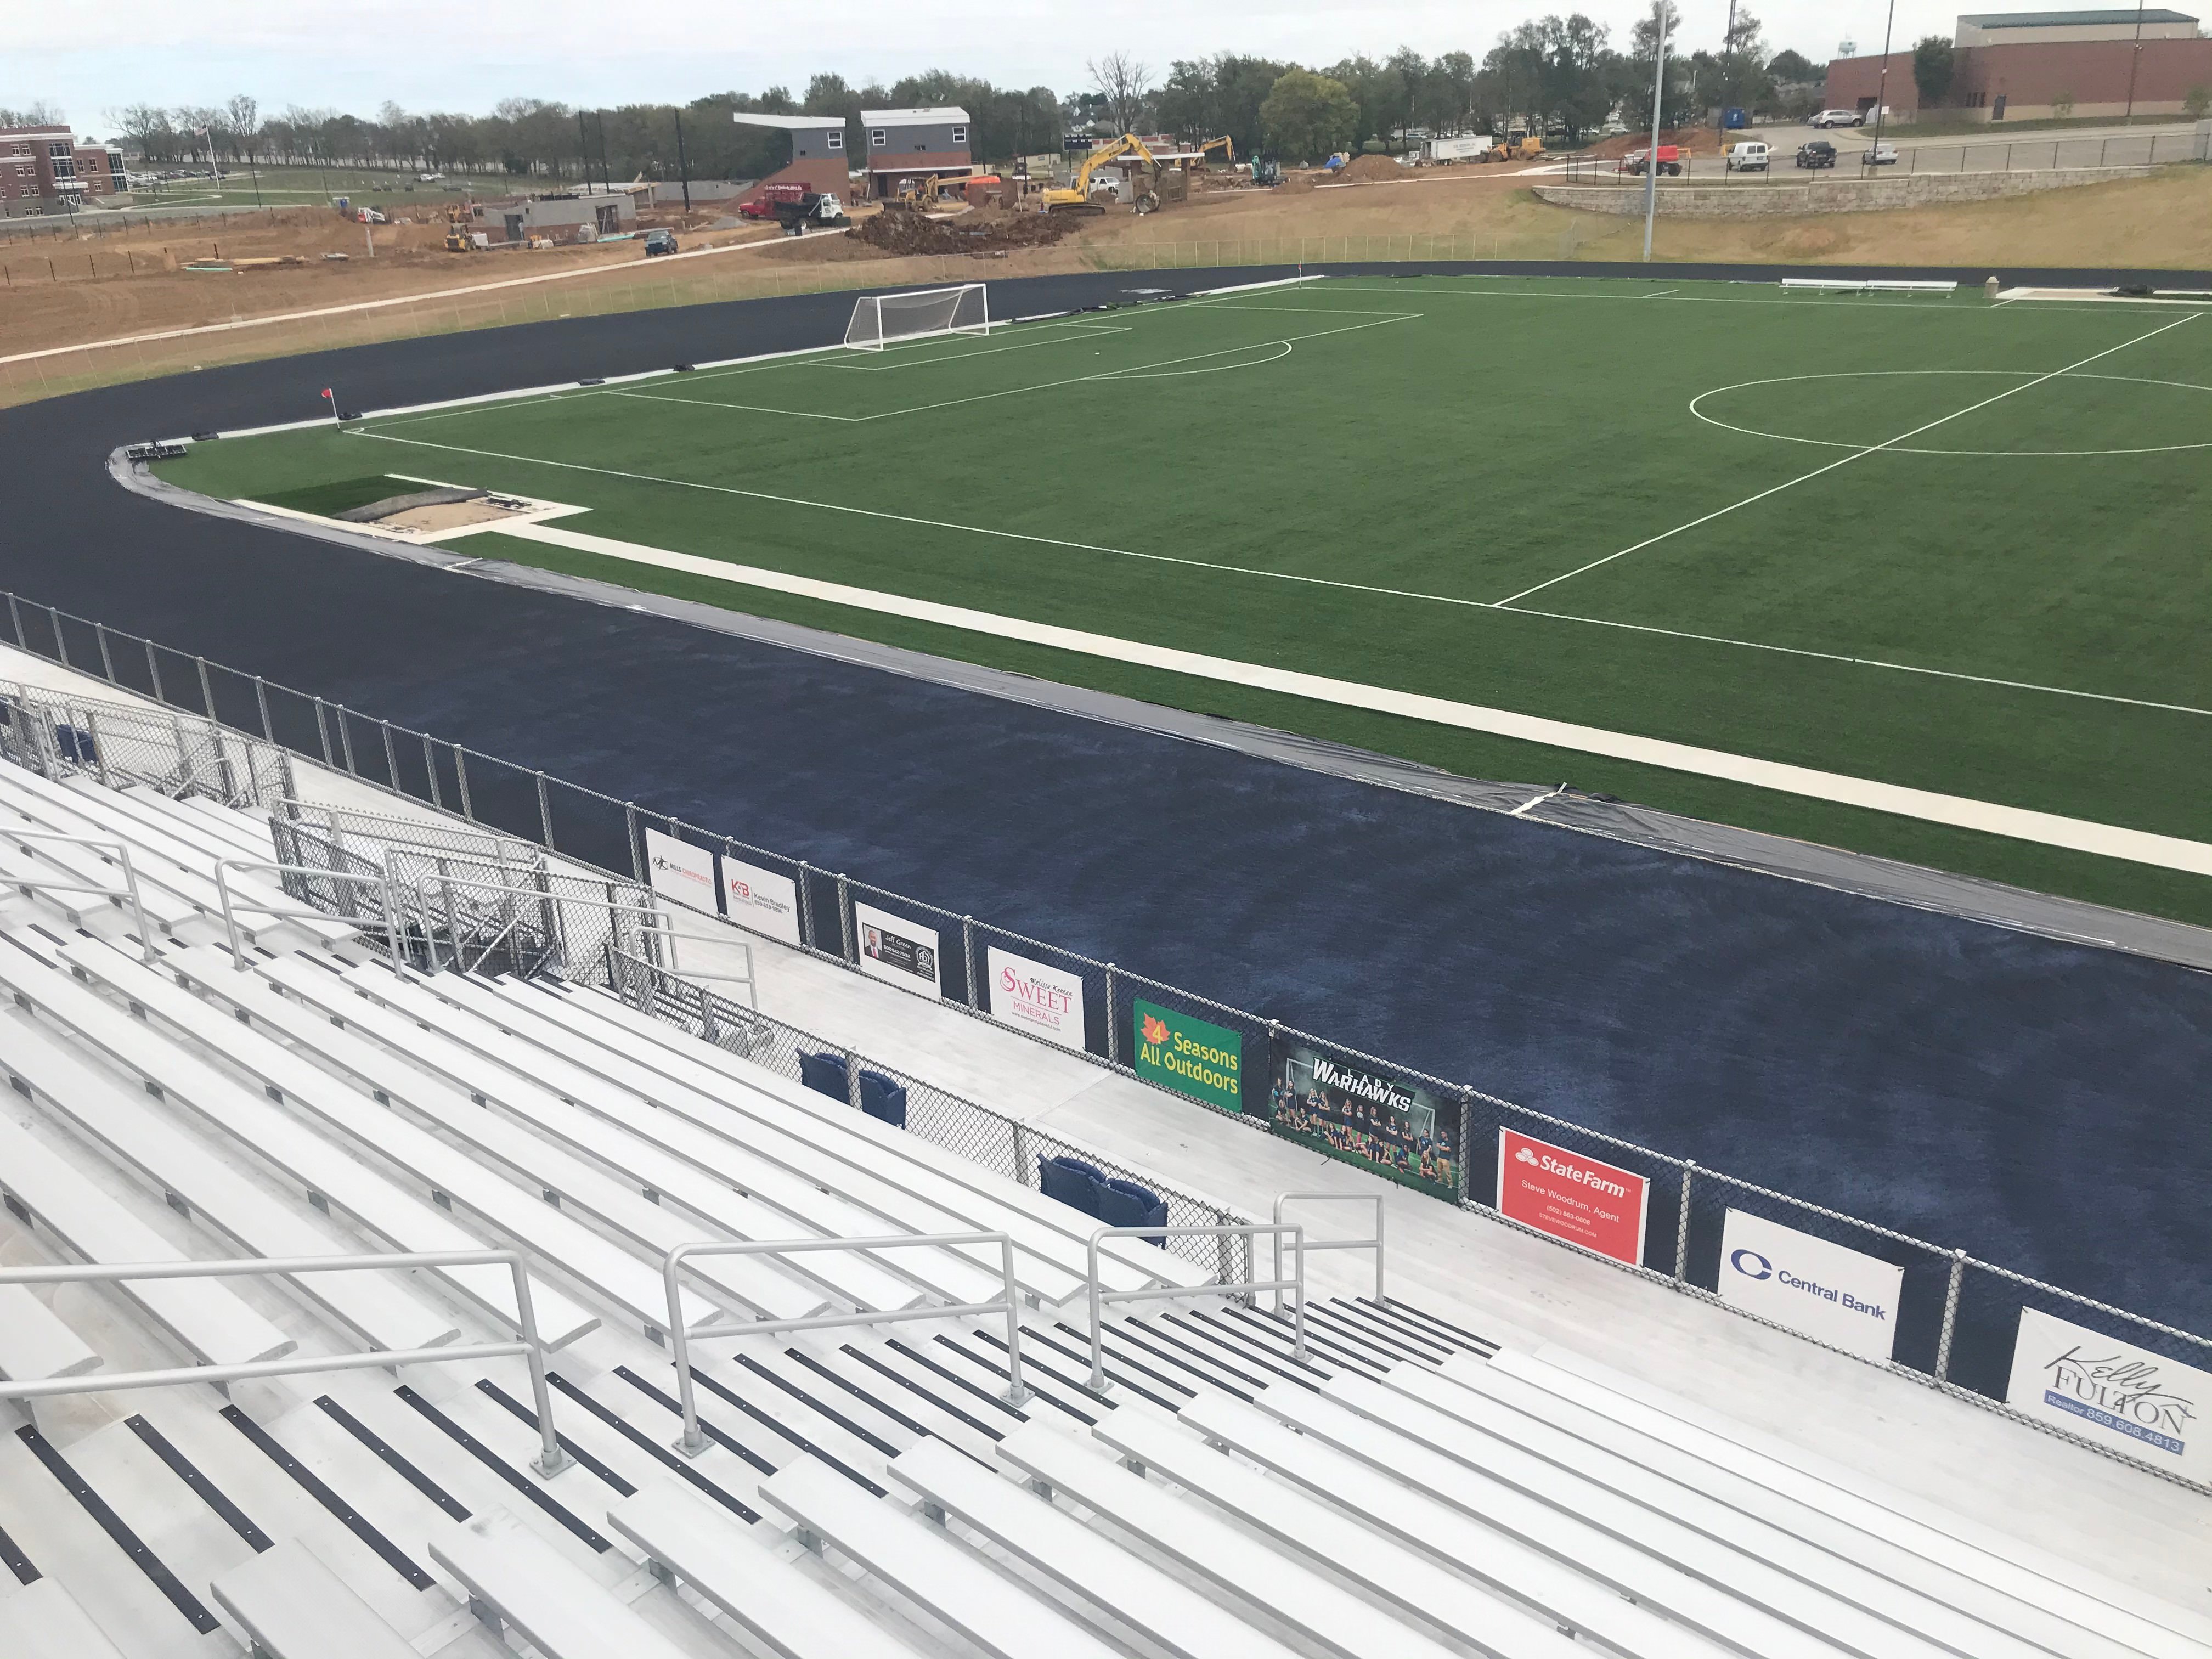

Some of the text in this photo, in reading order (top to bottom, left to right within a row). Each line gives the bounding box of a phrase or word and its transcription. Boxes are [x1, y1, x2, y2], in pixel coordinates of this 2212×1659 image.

[754, 893, 769, 903] Kevin
[770, 899, 790, 912] Bradley
[896, 939, 911, 949] Green
[1000, 967, 1072, 1013] SWEET
[1030, 978, 1051, 989] Melissa
[1014, 1001, 1060, 1025] MINERALS
[1152, 1025, 1238, 1070] 4 Seasons
[1141, 1043, 1238, 1094] All Outdoors
[1313, 1058, 1412, 1113] WARHAWKS
[1347, 1069, 1395, 1091] LADY
[1521, 1180, 1620, 1223] Steve Woodrum, Agent
[1547, 1205, 1562, 1215] (502)
[1539, 1212, 1597, 1238] STEVEWOODRUM.COM
[1779, 1270, 1887, 1321] Central Bank
[2044, 1346, 2194, 1408] Kelly
[2047, 1394, 2085, 1415] Realtor
[2052, 1365, 2188, 1435] FULTON
